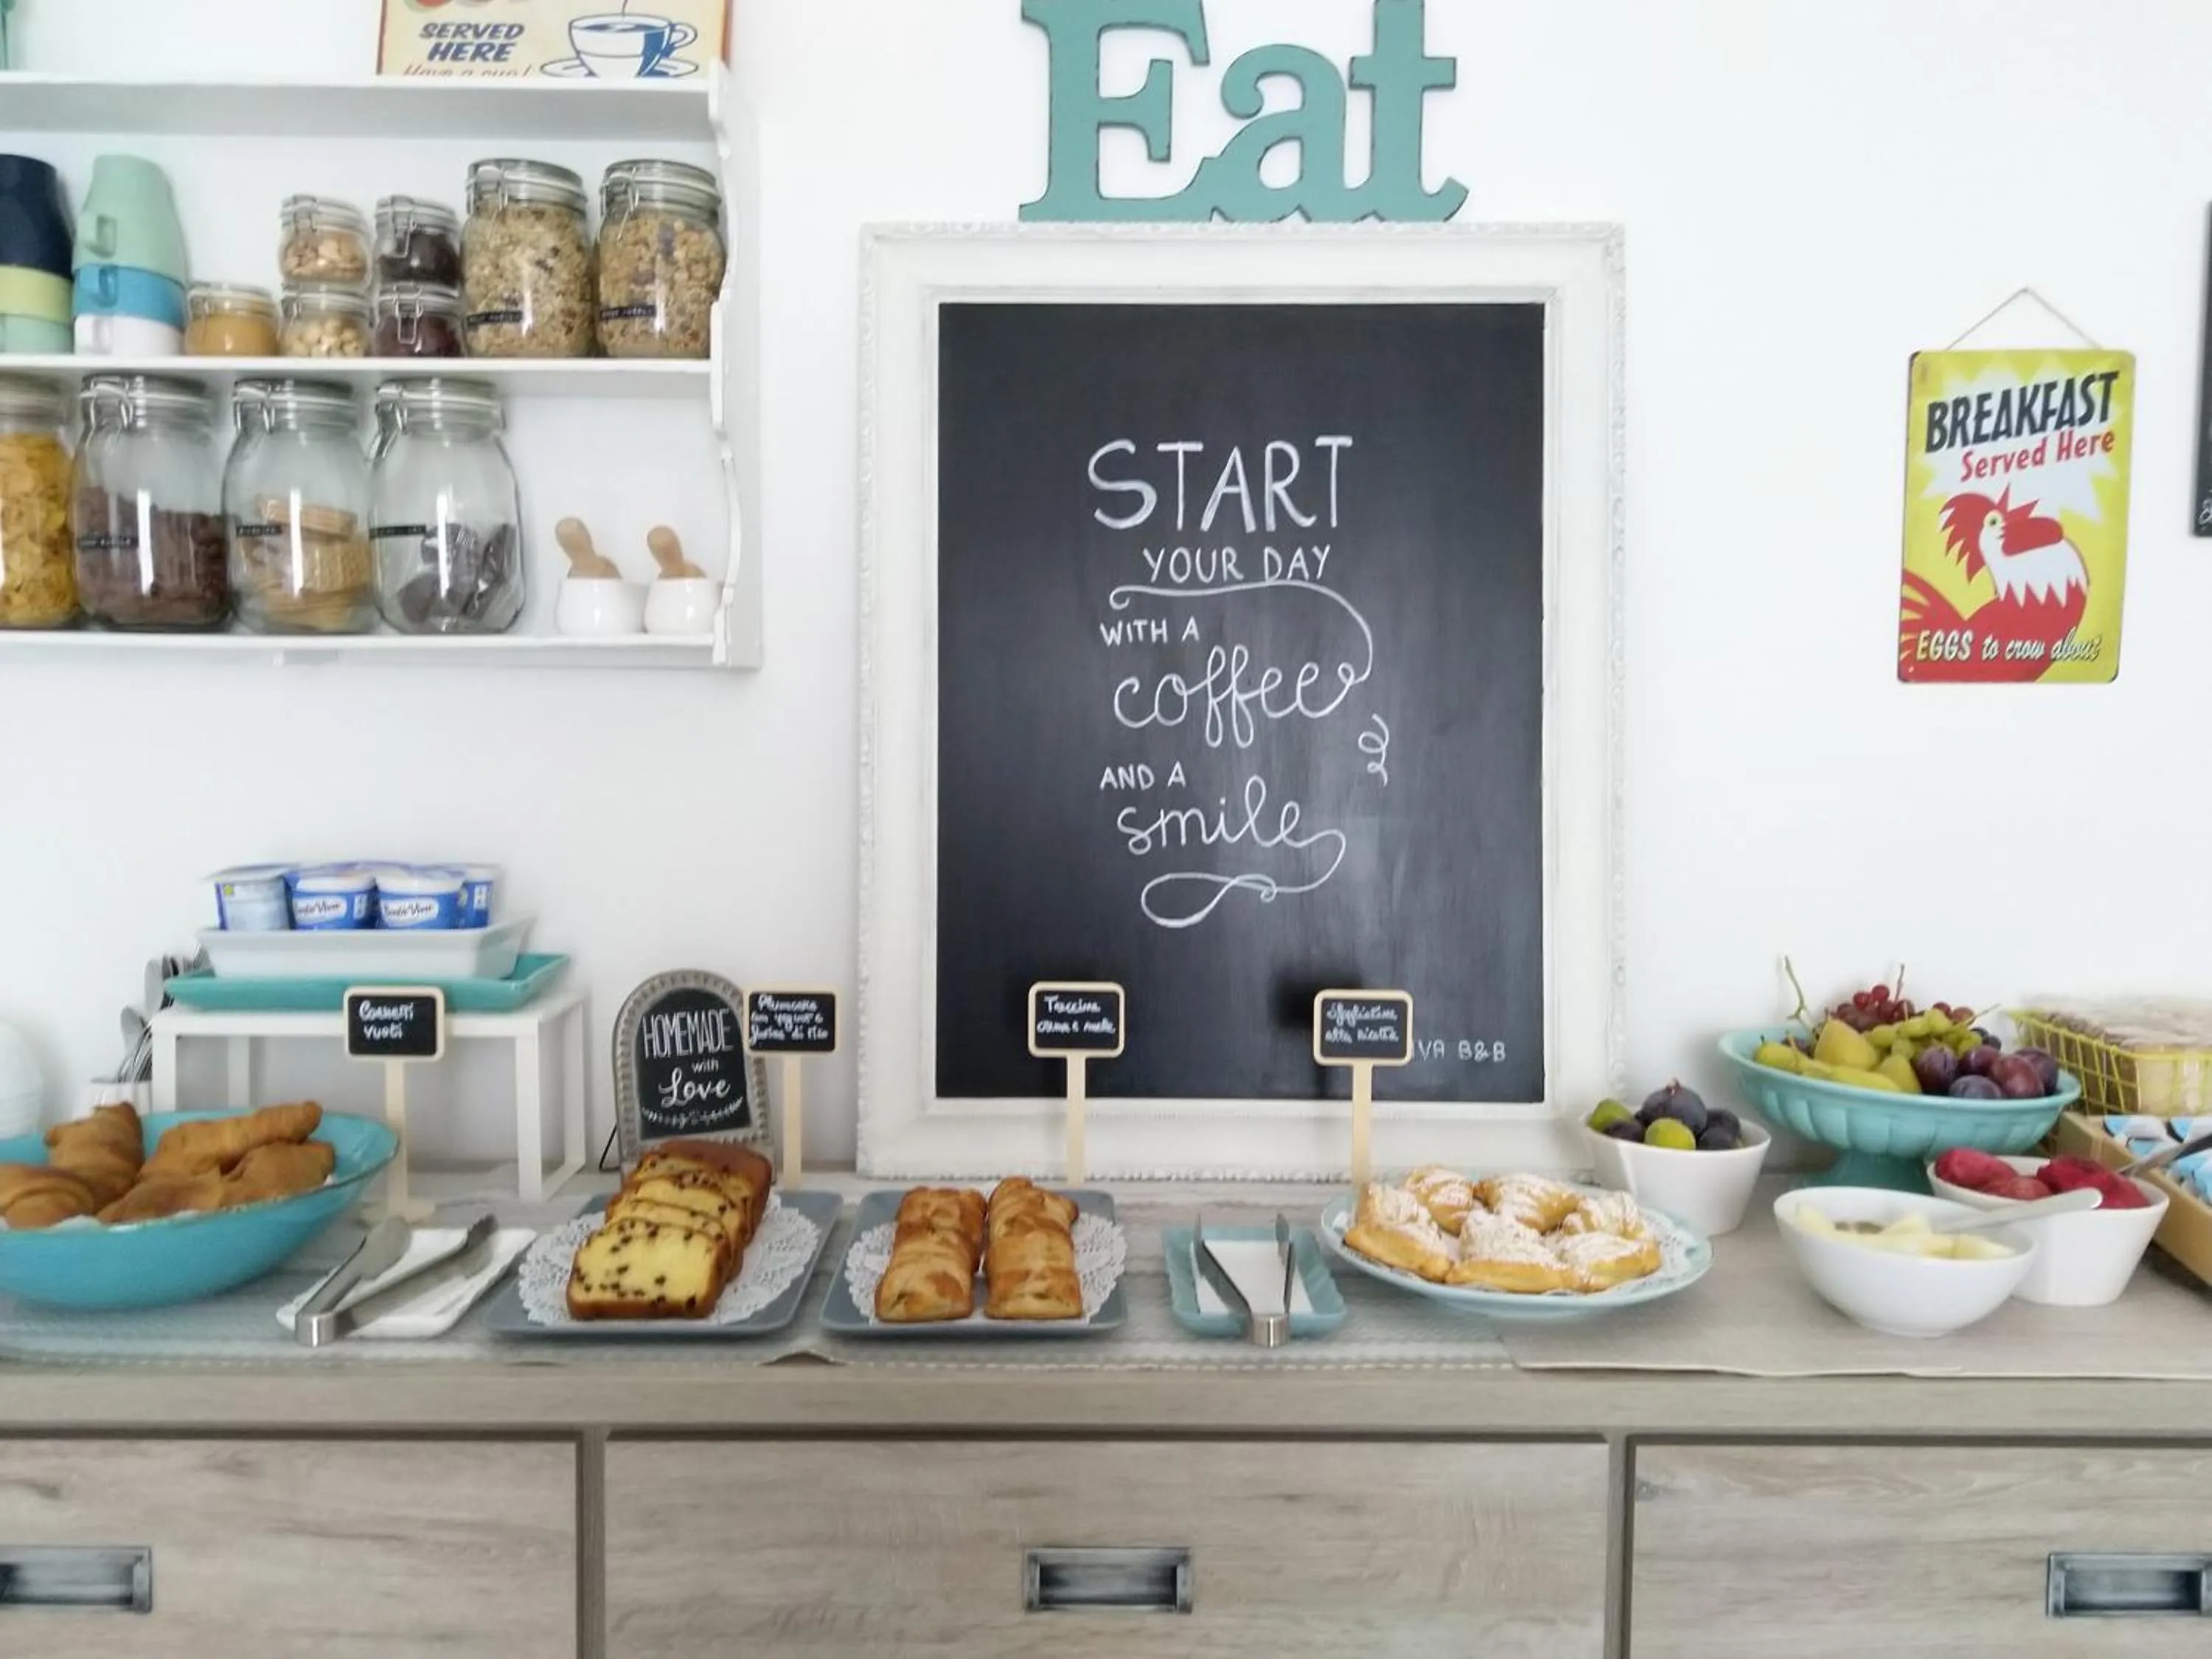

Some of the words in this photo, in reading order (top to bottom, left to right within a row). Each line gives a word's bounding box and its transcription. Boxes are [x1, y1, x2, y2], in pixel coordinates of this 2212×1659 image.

[419, 22, 525, 41] SERVED
[426, 42, 516, 63] HERE
[1018, 0, 1469, 222] Eat
[1925, 372, 2120, 453] BREAKFAST
[1961, 441, 2045, 483] Served
[2056, 431, 2115, 463] Here
[1088, 436, 1352, 532] START
[1142, 546, 1244, 583] YOUR
[1264, 544, 1330, 582] DAY
[1100, 618, 1169, 647] WITH
[1182, 616, 1200, 643] A
[1916, 630, 1974, 661] EGGS
[1982, 634, 2000, 661] to
[2005, 638, 2046, 661] crow
[2050, 625, 2102, 662] about
[1114, 644, 1355, 748] coffee
[1100, 763, 1155, 790] AND
[1167, 762, 1186, 787] A
[1118, 775, 1320, 855] smile
[642, 1007, 734, 1060] HOMEMADE
[1458, 1039, 1506, 1063] B&B
[692, 1058, 720, 1074] with
[658, 1067, 731, 1108] Love
